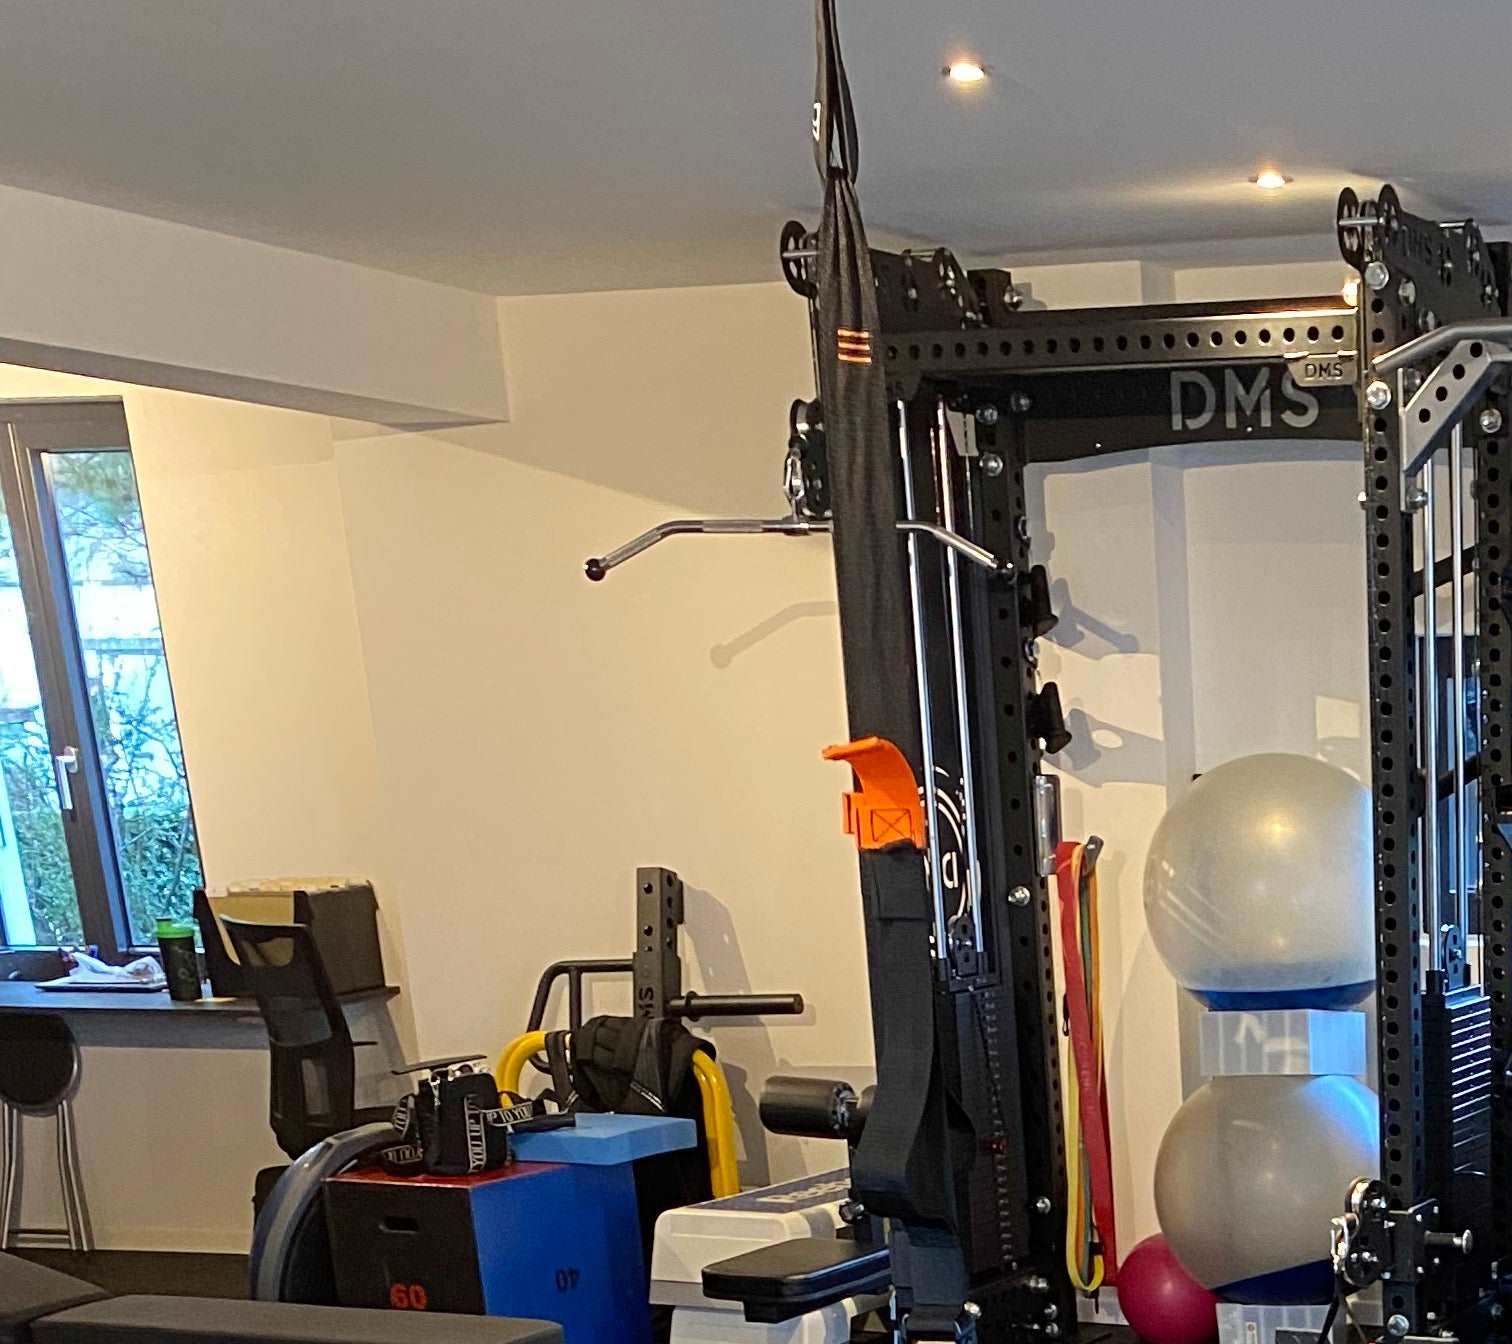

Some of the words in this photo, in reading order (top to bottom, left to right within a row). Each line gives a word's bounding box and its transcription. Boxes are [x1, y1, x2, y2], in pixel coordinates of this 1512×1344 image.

[1304, 361, 1343, 379] DMS
[1169, 367, 1319, 431] DMS
[390, 1282, 428, 1309] 60
